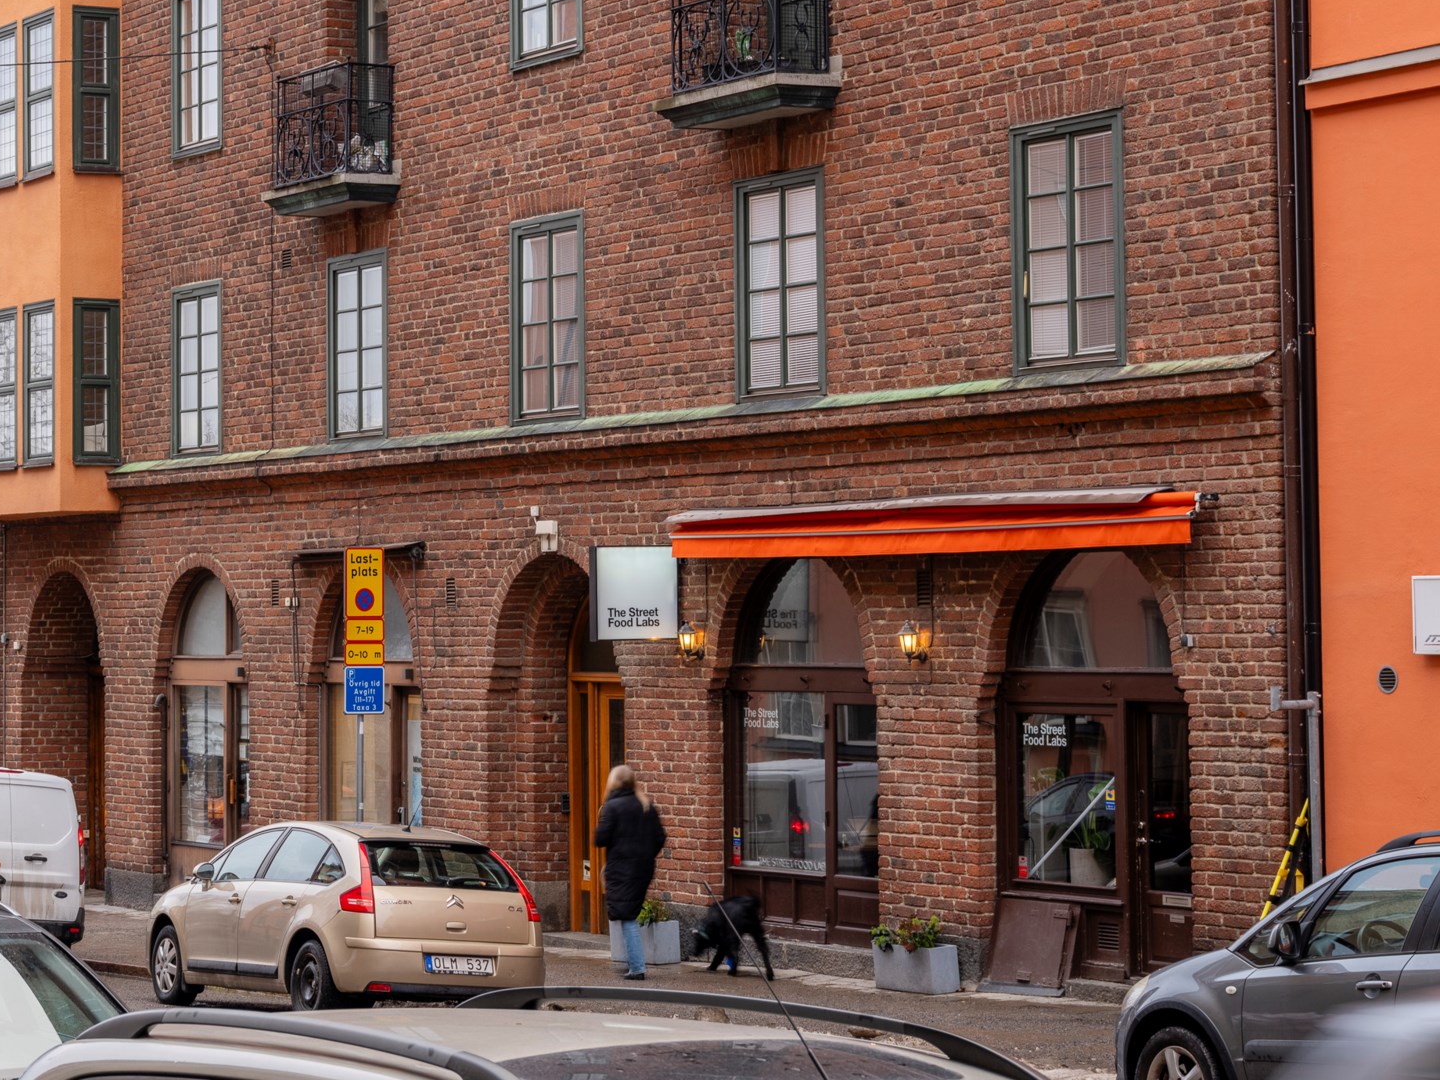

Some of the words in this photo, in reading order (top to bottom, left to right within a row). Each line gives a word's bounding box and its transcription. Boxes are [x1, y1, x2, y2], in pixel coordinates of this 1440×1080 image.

[350, 553, 378, 564] Last-
[351, 566, 378, 579] plats
[607, 608, 626, 617] The
[628, 607, 659, 617] Street
[608, 618, 633, 627] Food
[636, 617, 660, 627] Labs
[356, 626, 374, 634] 7-19
[348, 650, 368, 658] 0-10
[349, 680, 368, 688] Övrig
[354, 688, 376, 696] Avgift
[744, 708, 756, 717] The
[758, 708, 778, 718] Street
[744, 718, 761, 727] Food
[763, 718, 780, 728] Labs
[1023, 723, 1038, 734] The
[1040, 723, 1066, 735] Street
[1023, 734, 1044, 745] Food
[1046, 735, 1067, 747] Labs
[434, 957, 458, 969] OLM
[467, 959, 489, 971] 537
